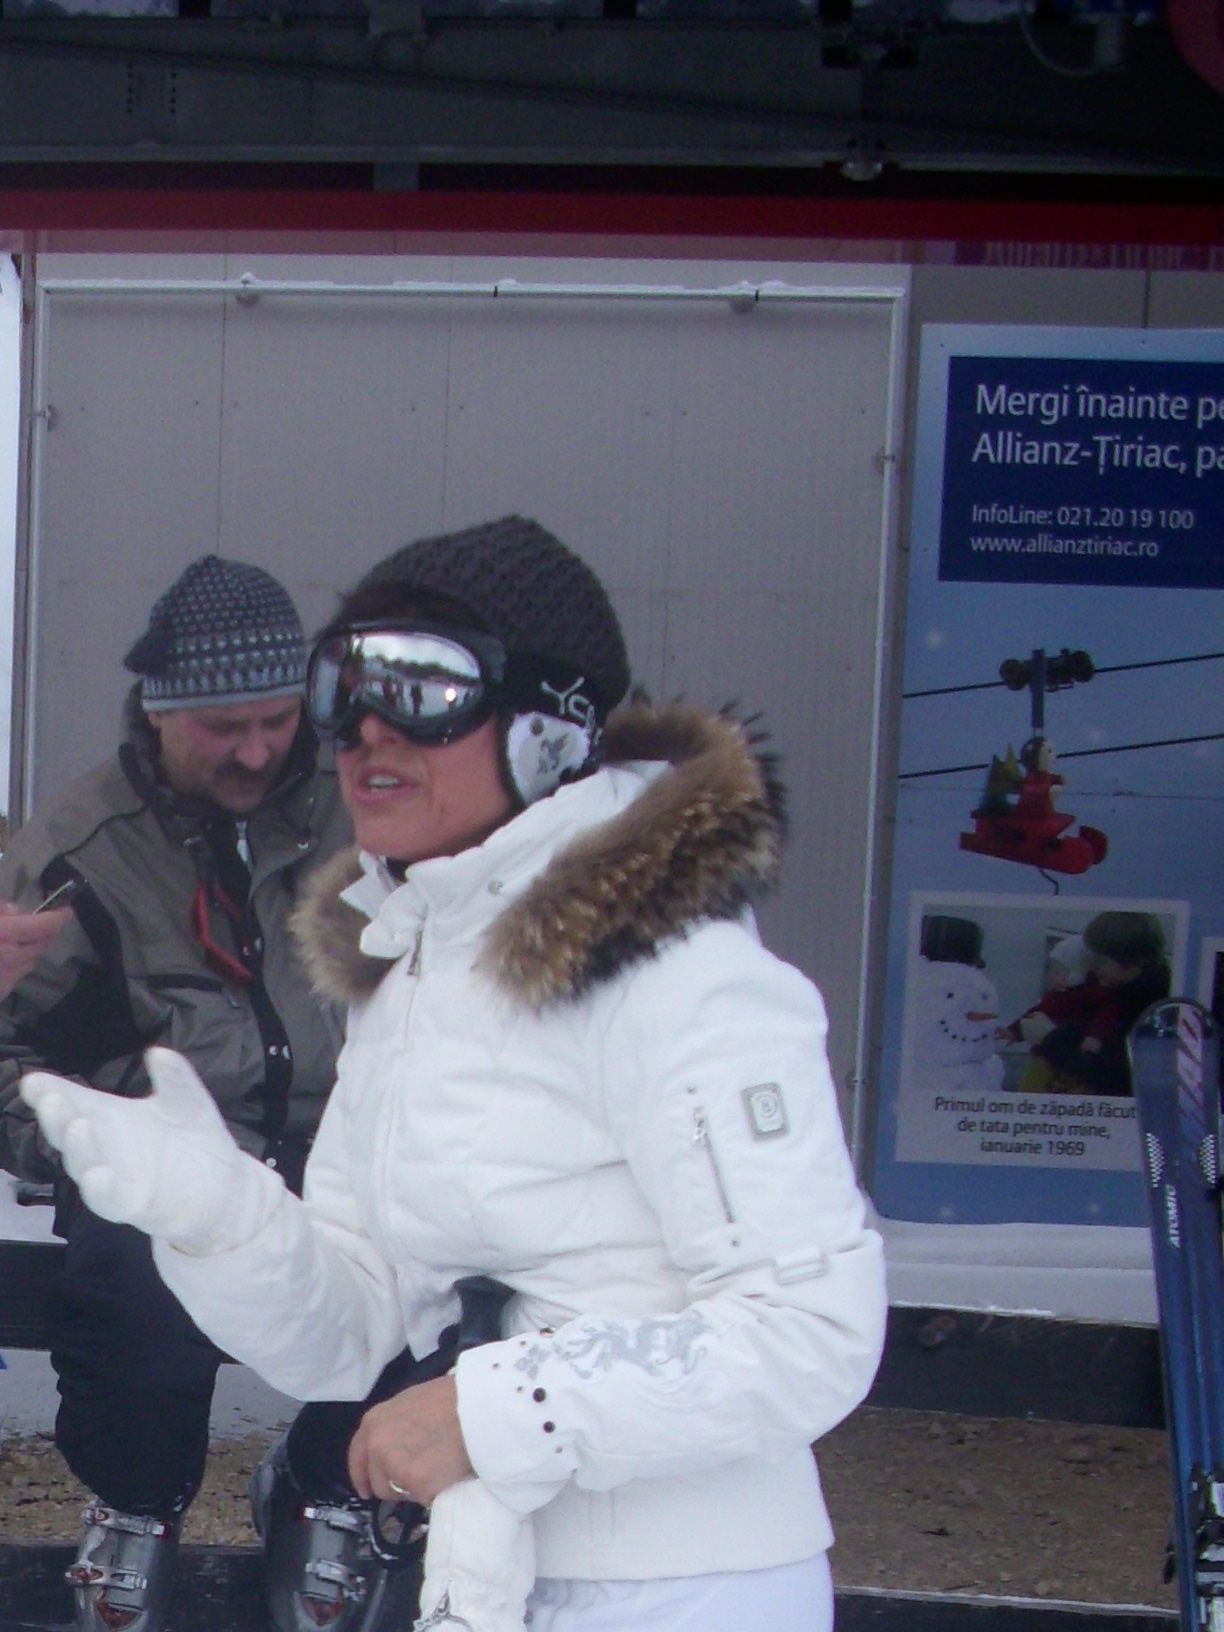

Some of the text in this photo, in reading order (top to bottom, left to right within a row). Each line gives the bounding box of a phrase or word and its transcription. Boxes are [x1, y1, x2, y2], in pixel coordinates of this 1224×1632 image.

[975, 383, 1071, 426] Mergi
[1077, 384, 1189, 421] înainte
[971, 503, 1195, 530] InfoLine: 021.20 19 100
[970, 533, 1159, 557] www.allianztiriac.ro
[934, 1096, 985, 1113] Primul
[989, 1102, 1014, 1114] om
[1018, 1099, 1037, 1115] de
[957, 1118, 977, 1132] de
[980, 1120, 1009, 1134] tata
[1013, 1122, 1065, 1138] pentru
[980, 1138, 1086, 1157] ianuarie 1969
